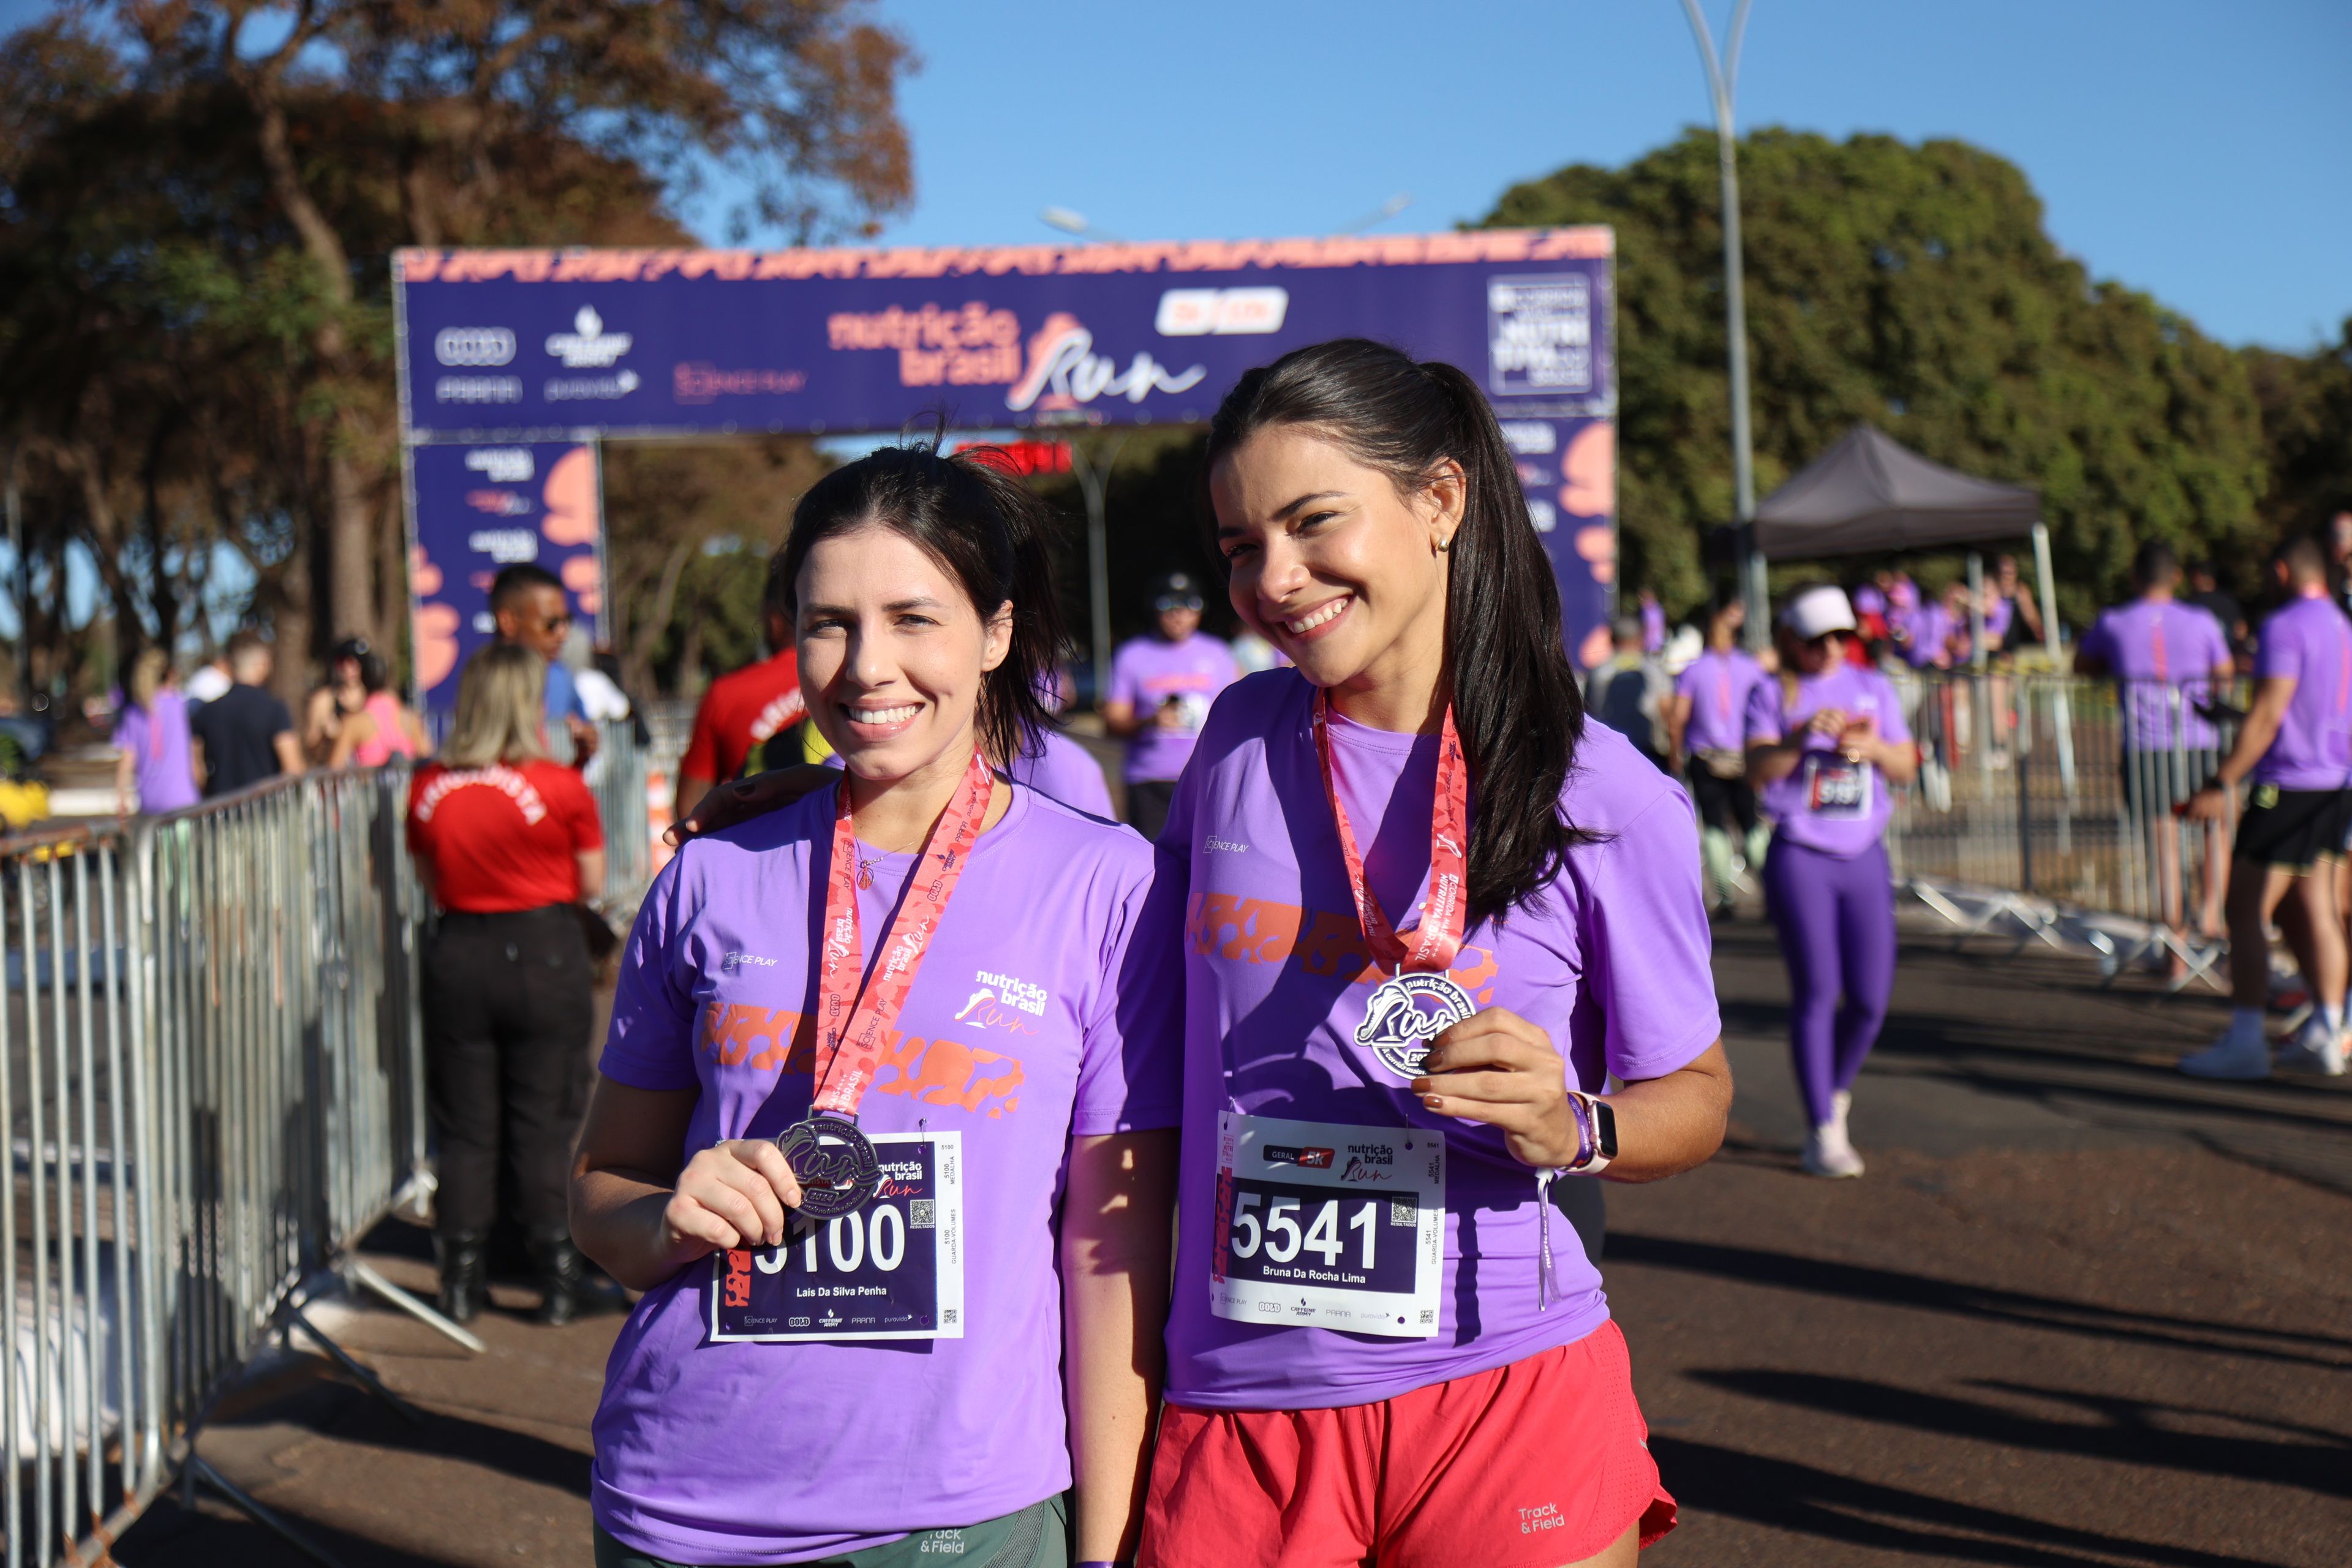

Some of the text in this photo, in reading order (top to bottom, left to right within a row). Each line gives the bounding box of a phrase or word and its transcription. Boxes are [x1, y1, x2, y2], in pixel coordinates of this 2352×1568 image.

[898, 343, 1022, 386] brasil
[1230, 843, 1249, 853] PLAY
[1431, 873, 1448, 919] NUTRITIVA
[1446, 882, 1457, 916] CORRIDA
[835, 918, 846, 943] brasil
[844, 907, 854, 944] nutrição
[1415, 922, 1439, 960] BRASIL
[755, 957, 778, 967] PLAY
[883, 945, 904, 981] nutrição
[895, 946, 913, 972] brasil
[976, 970, 1047, 1001] nutrição
[1406, 979, 1452, 994] nutrição
[1001, 989, 1046, 1017] brasil
[861, 997, 888, 1048] SCIENCE PLAY
[954, 997, 1039, 1035] Run
[842, 1070, 863, 1102] BRASIL
[815, 1123, 873, 1167] nutrição brasil
[1348, 1144, 1393, 1155] nutrição
[1272, 1151, 1294, 1160] GERAL
[1365, 1154, 1393, 1165] brasil
[878, 1161, 922, 1172] nutrição
[895, 1170, 922, 1180] brasil
[810, 1193, 833, 1202] 2024
[1232, 1192, 1377, 1269] 5541
[1263, 1265, 1366, 1284] Bruna Da Rocha Lima
[797, 1286, 887, 1297] Lais Da Silva Penha
[1259, 1302, 1281, 1313] BOLD
[788, 1317, 810, 1327] BOLD
[1518, 1502, 1558, 1520] Track
[1521, 1514, 1565, 1534] & Field
[925, 1529, 962, 1539] ack
[921, 1540, 965, 1553] & Field
